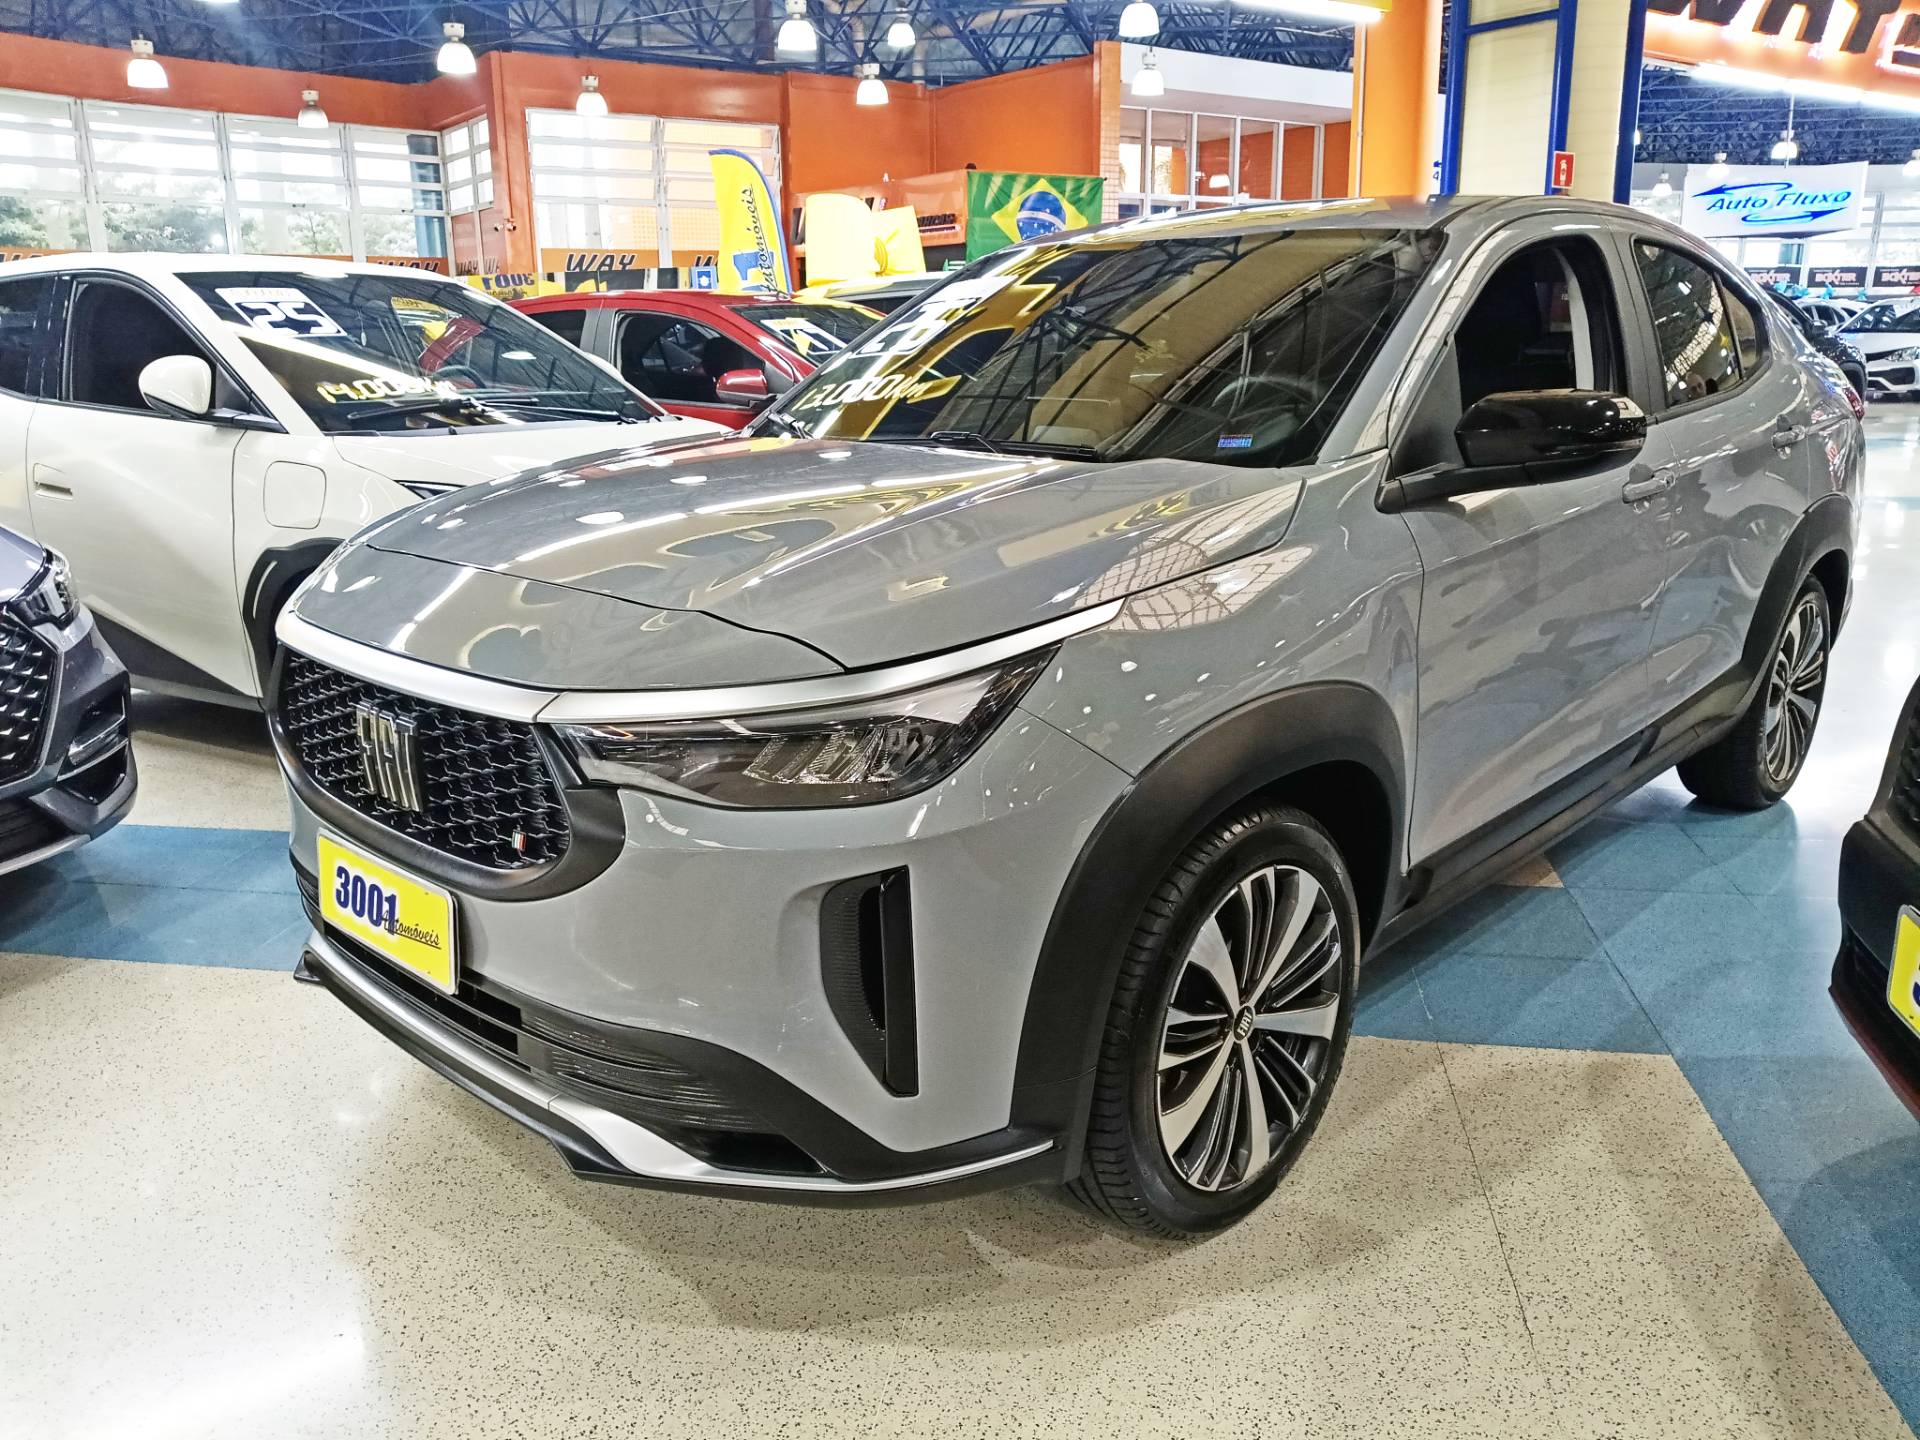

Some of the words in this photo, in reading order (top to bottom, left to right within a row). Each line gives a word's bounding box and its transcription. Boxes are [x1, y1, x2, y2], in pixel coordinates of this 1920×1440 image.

[1706, 194, 1769, 211] Auto
[1775, 191, 1852, 206] Fluxo
[565, 253, 638, 272] WAY
[240, 301, 342, 334] 25
[335, 865, 397, 936] 3001
[1236, 1009, 1253, 1037] FIAT
